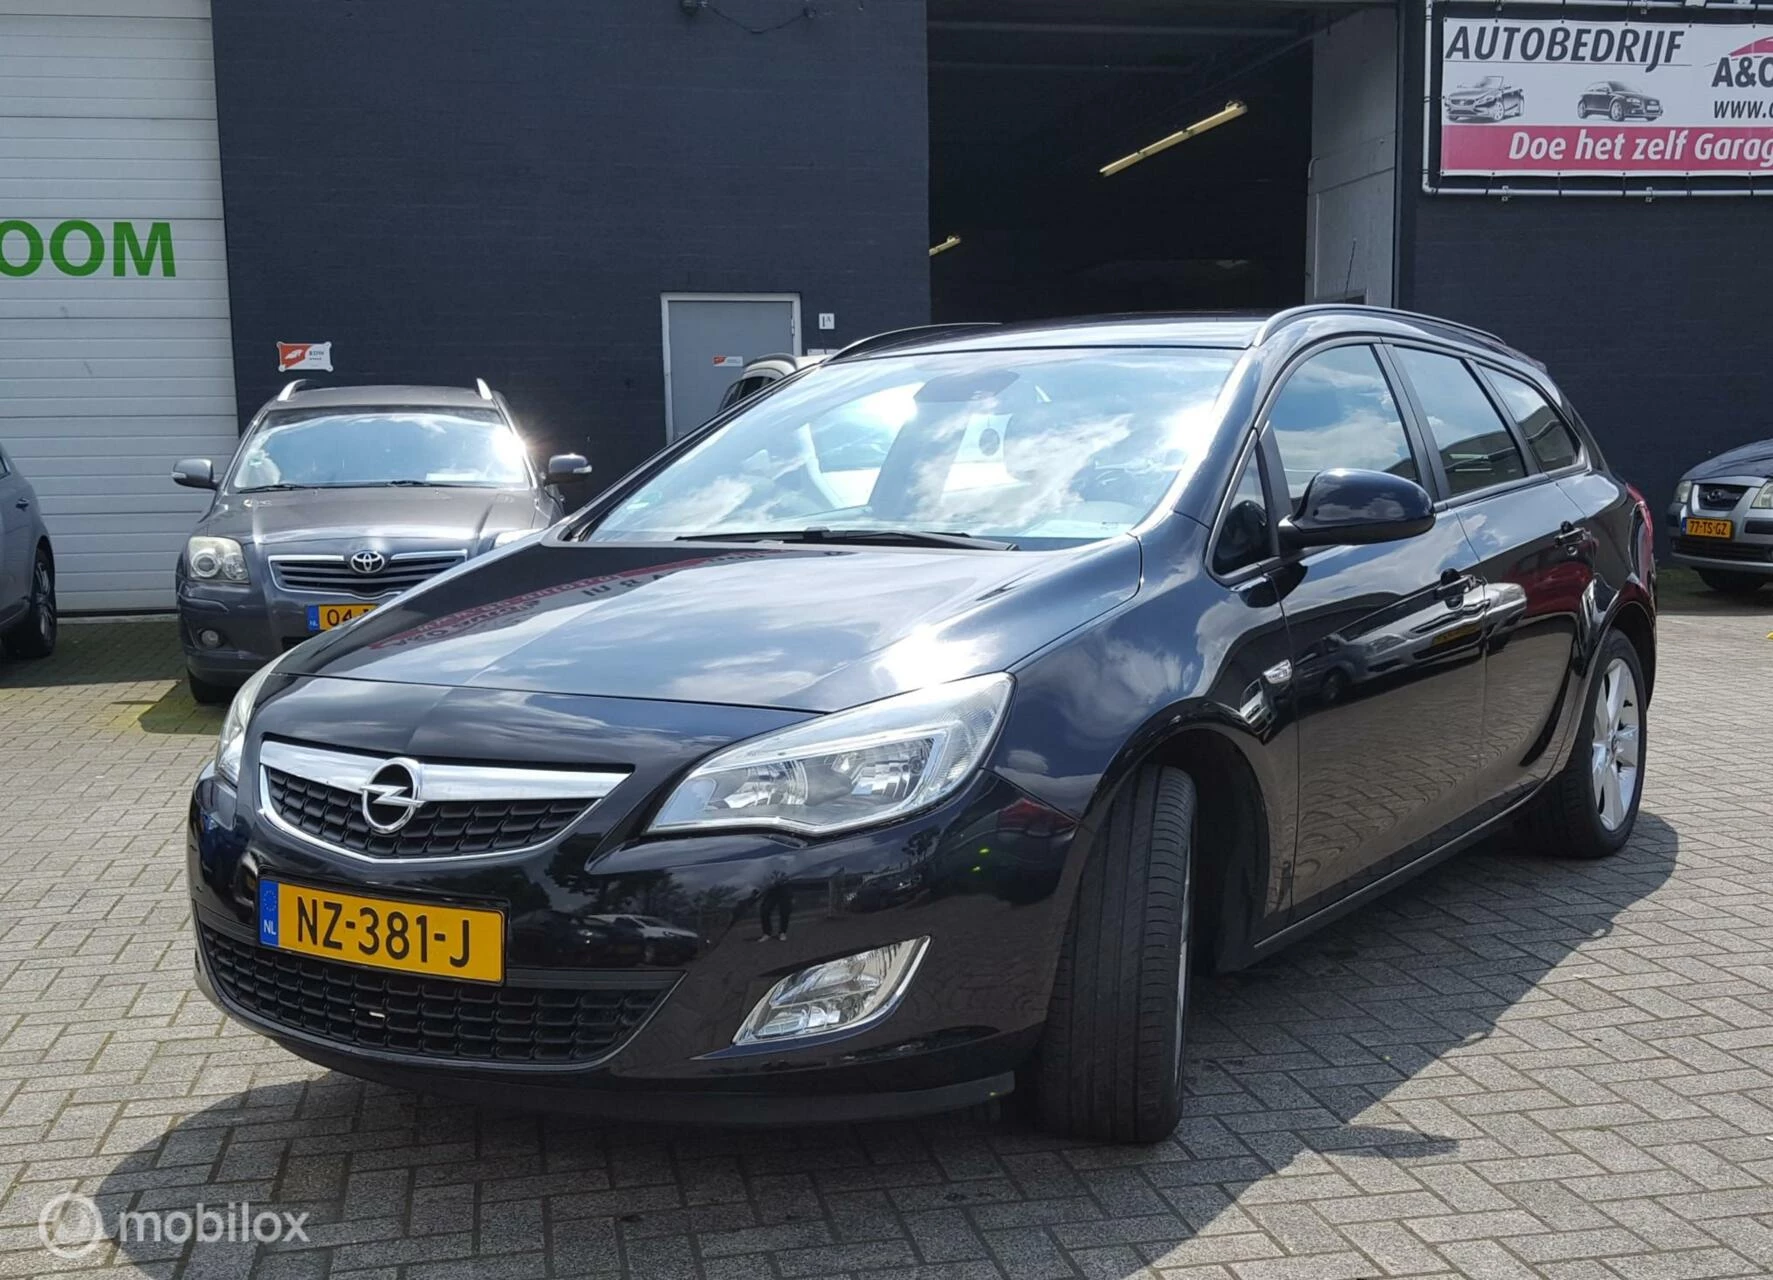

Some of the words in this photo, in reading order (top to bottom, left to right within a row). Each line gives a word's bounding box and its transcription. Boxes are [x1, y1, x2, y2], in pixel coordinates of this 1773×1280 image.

[1445, 26, 1685, 73] AUTOBEDRIJF
[1508, 131, 1564, 160] Doe
[1574, 129, 1625, 161] het
[1635, 129, 1688, 161] zelf
[1690, 521, 1728, 535] 77-TS-GZ
[263, 919, 276, 936] NL
[297, 896, 470, 968] NZ-381-J
